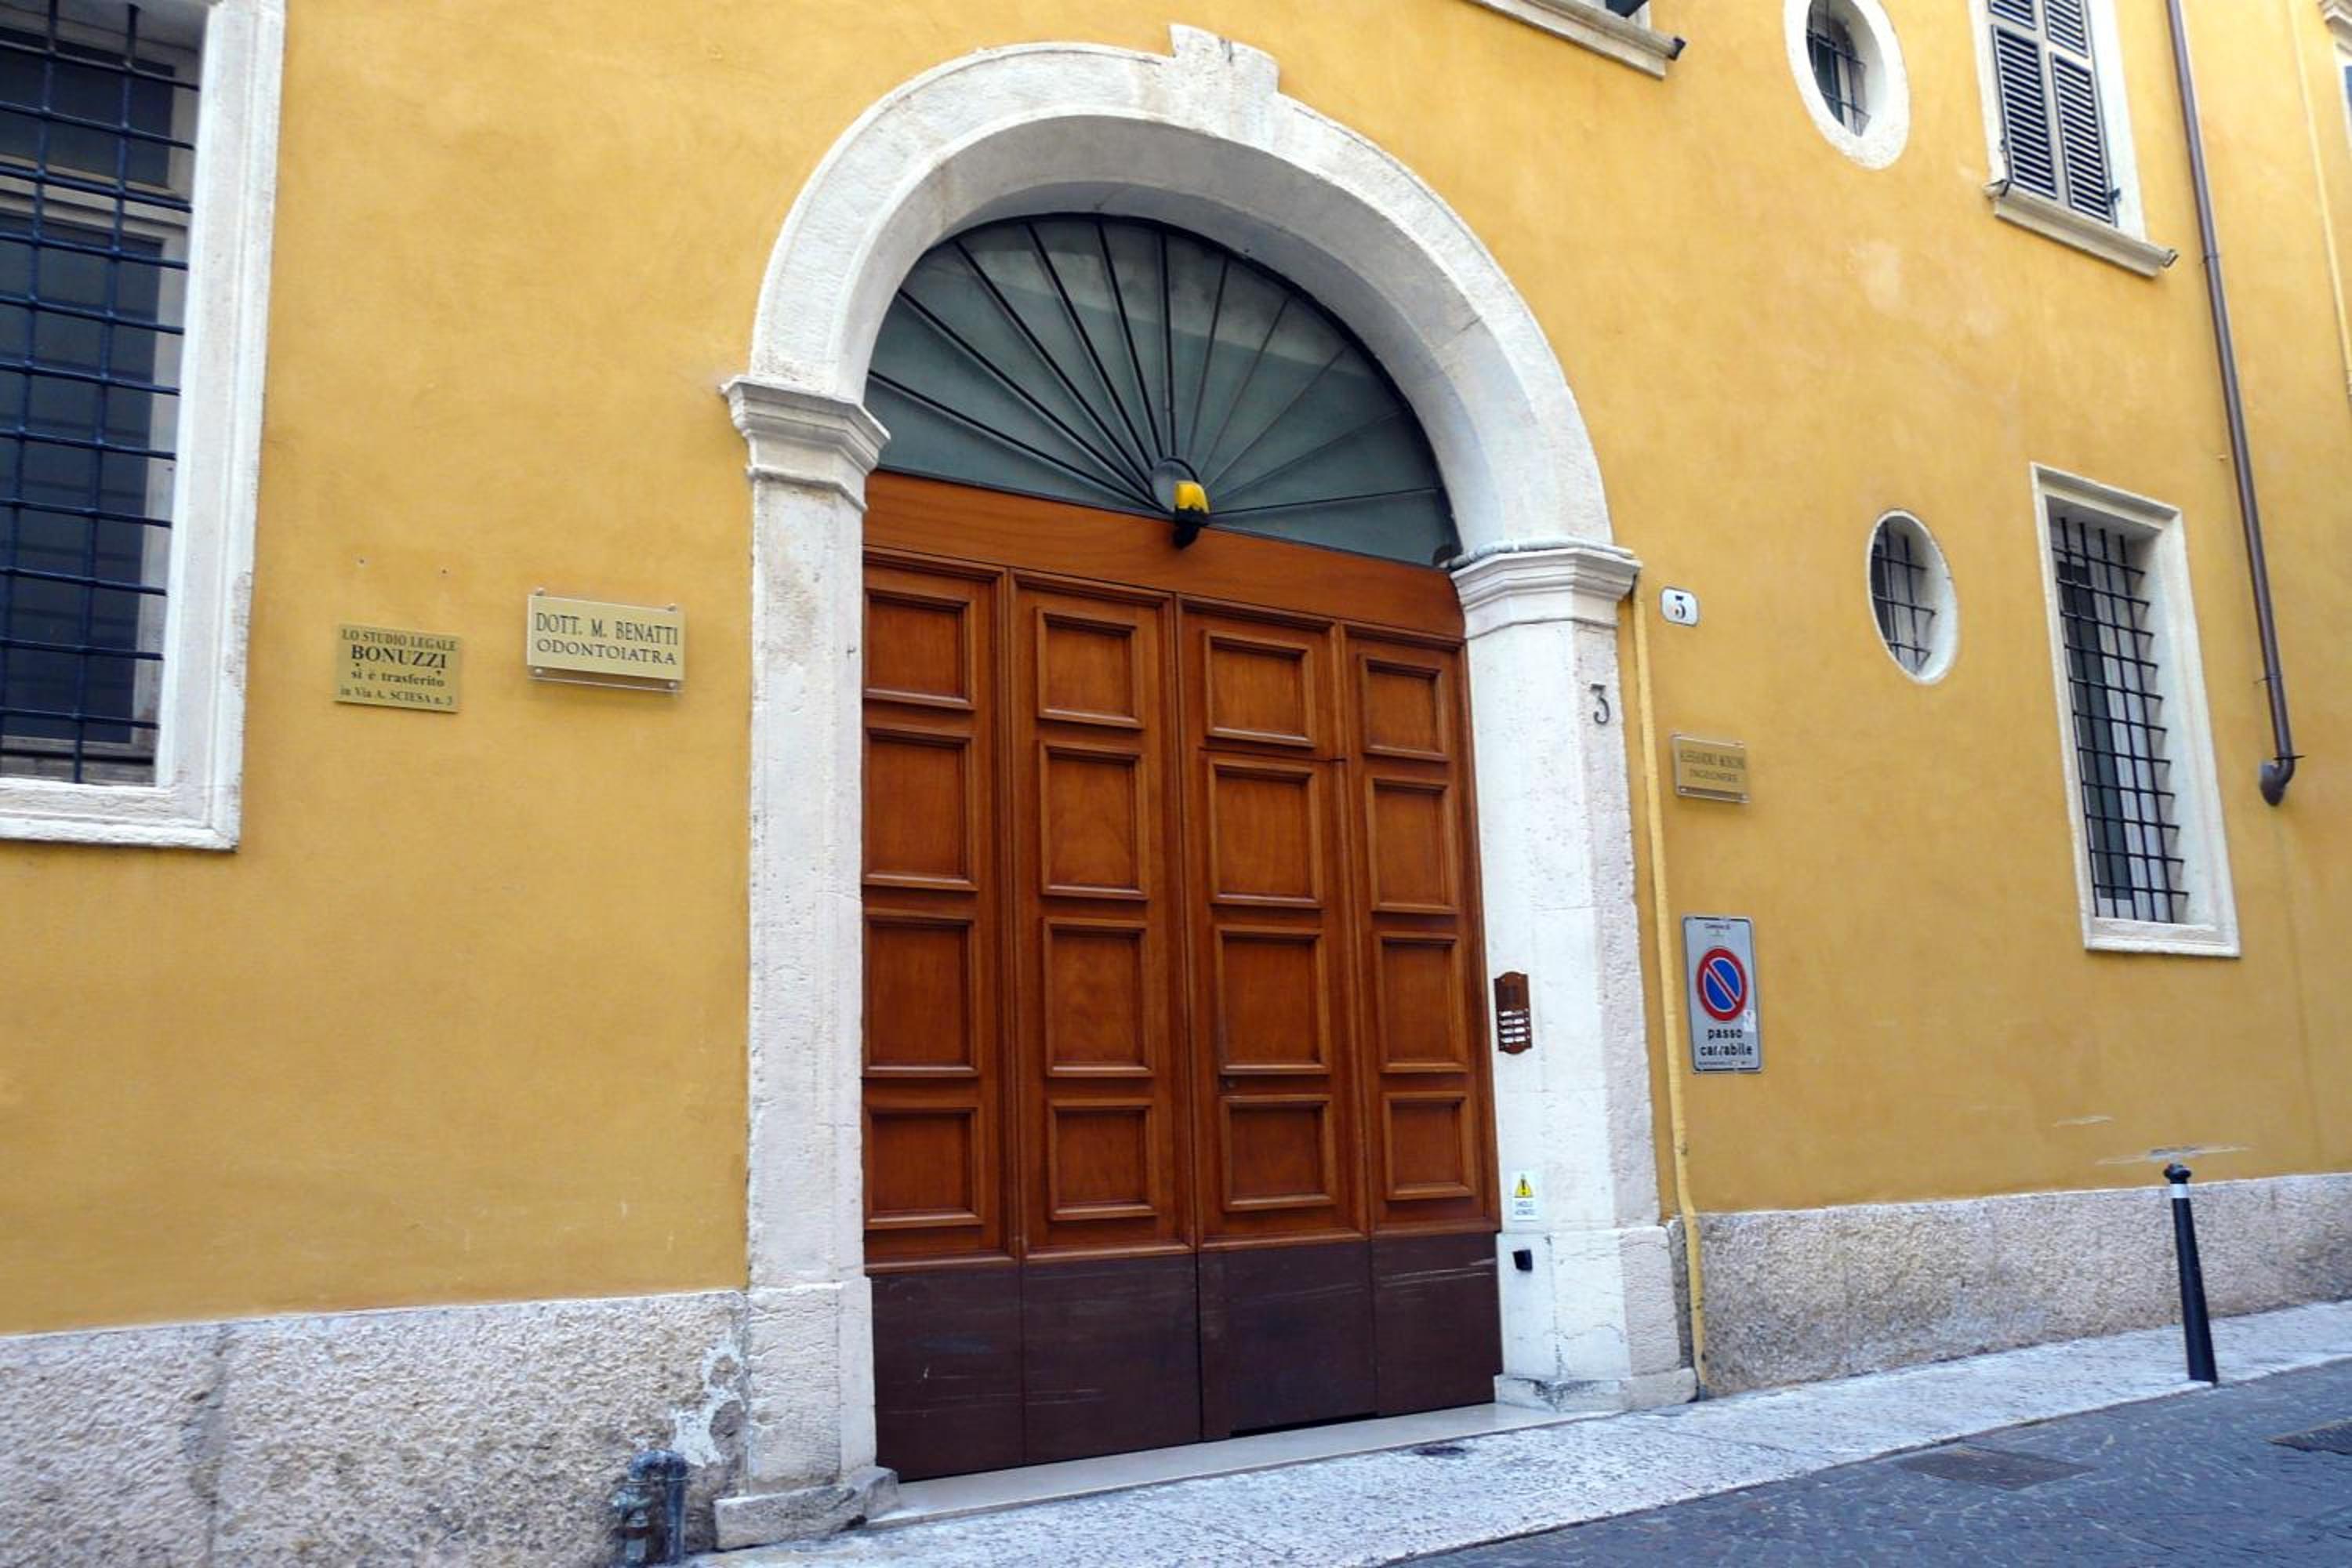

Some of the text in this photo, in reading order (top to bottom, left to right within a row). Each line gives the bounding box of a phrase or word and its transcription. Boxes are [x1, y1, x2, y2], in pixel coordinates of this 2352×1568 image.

[535, 612, 678, 645] DOTT. M. BENATTI
[341, 629, 456, 652] LO STUDIO LEGALE
[536, 639, 677, 665] ODONTOIATRA
[351, 644, 446, 669] BONUZZI
[381, 672, 445, 688] trasferito
[354, 687, 372, 699] Via
[1590, 683, 1610, 726] 3
[1707, 1028, 1743, 1041] passo
[1700, 1042, 1753, 1057] carrabile
